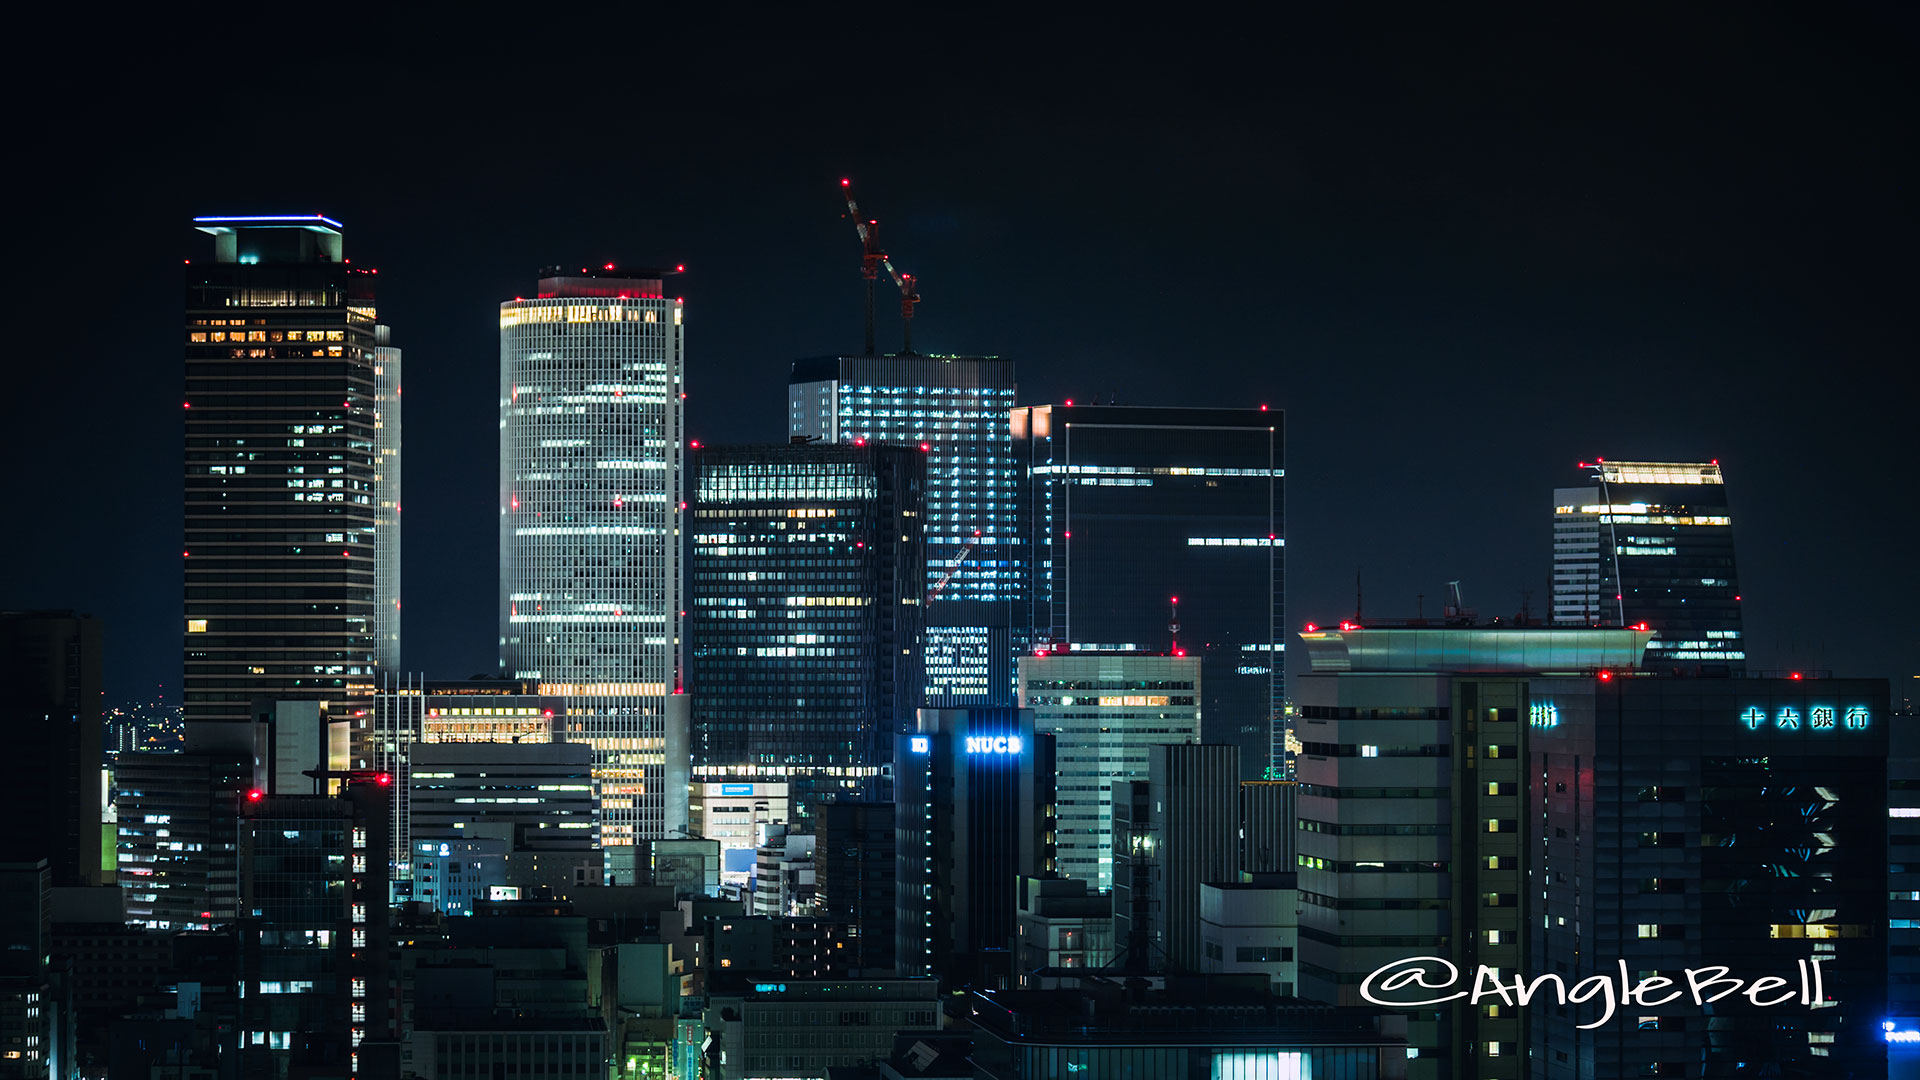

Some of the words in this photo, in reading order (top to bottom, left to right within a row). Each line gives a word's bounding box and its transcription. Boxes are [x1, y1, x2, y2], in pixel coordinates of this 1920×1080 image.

[1741, 708, 1868, 728] 十六銀行
[967, 737, 1021, 754] NUCB
